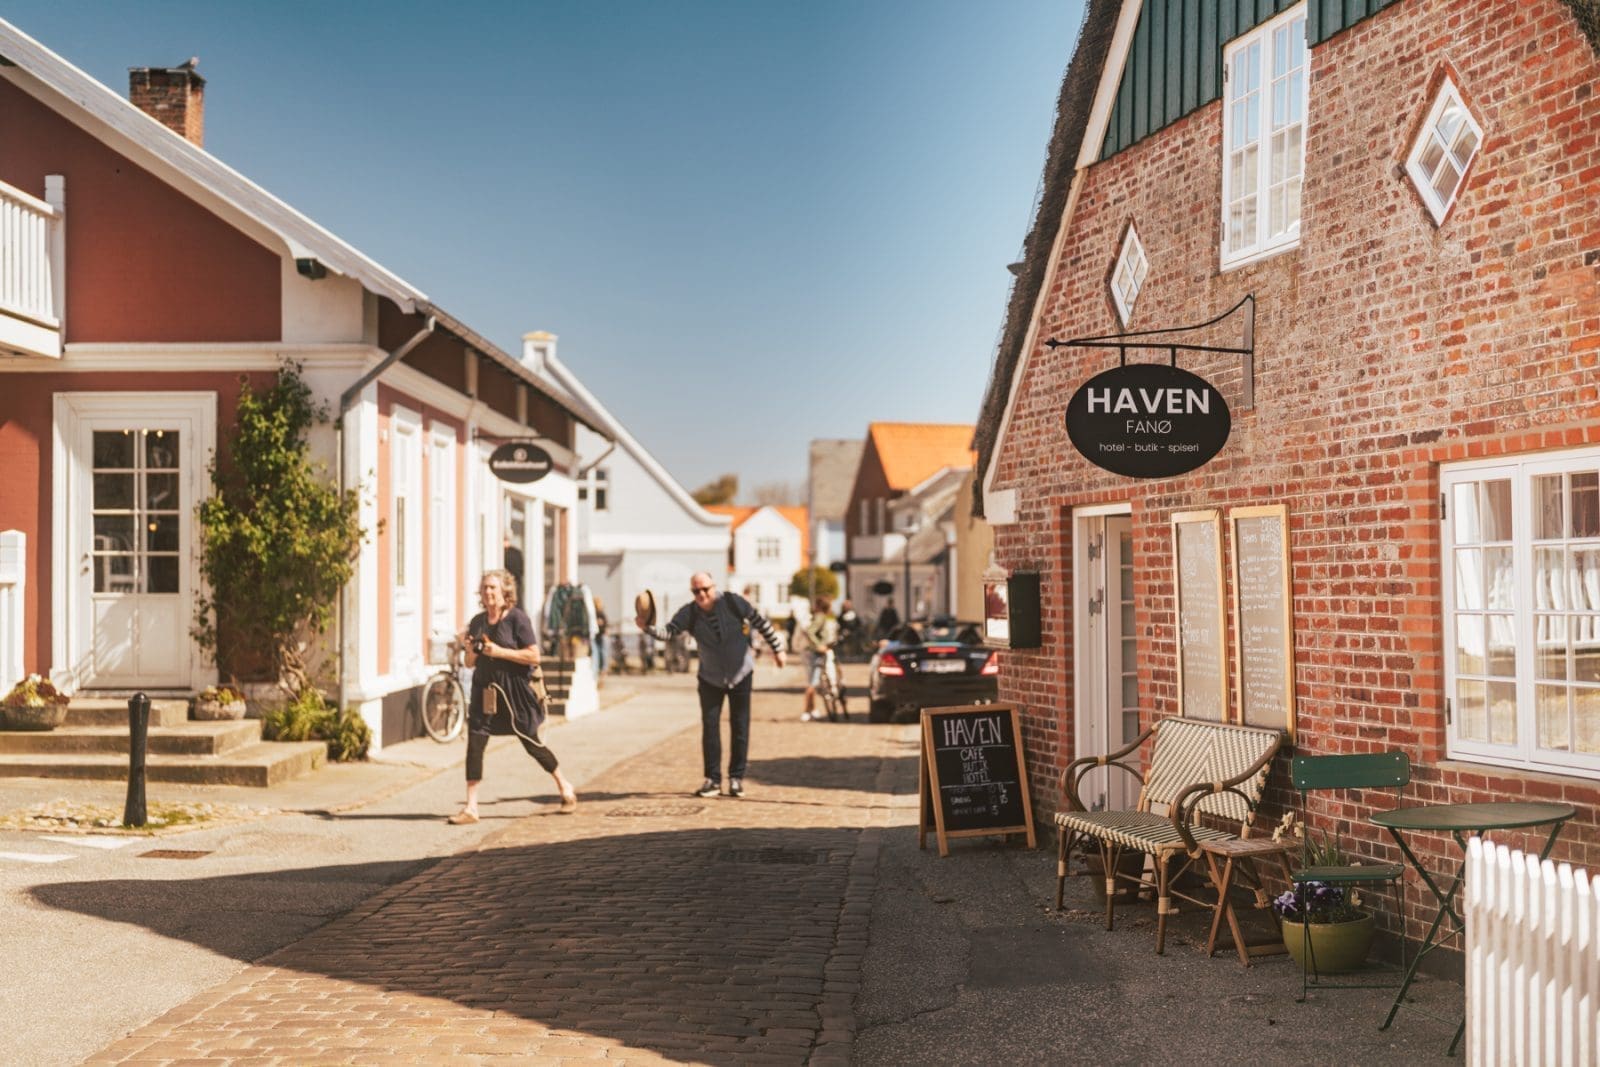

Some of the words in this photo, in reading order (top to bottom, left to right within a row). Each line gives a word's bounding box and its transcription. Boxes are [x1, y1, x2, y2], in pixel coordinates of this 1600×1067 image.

[1087, 387, 1210, 414] HAVEN
[1126, 419, 1172, 434] FANØ
[1100, 443, 1125, 452] hotel
[1135, 443, 1158, 452] butik
[1168, 443, 1199, 453] spiseri
[943, 716, 1002, 746] HAVEN
